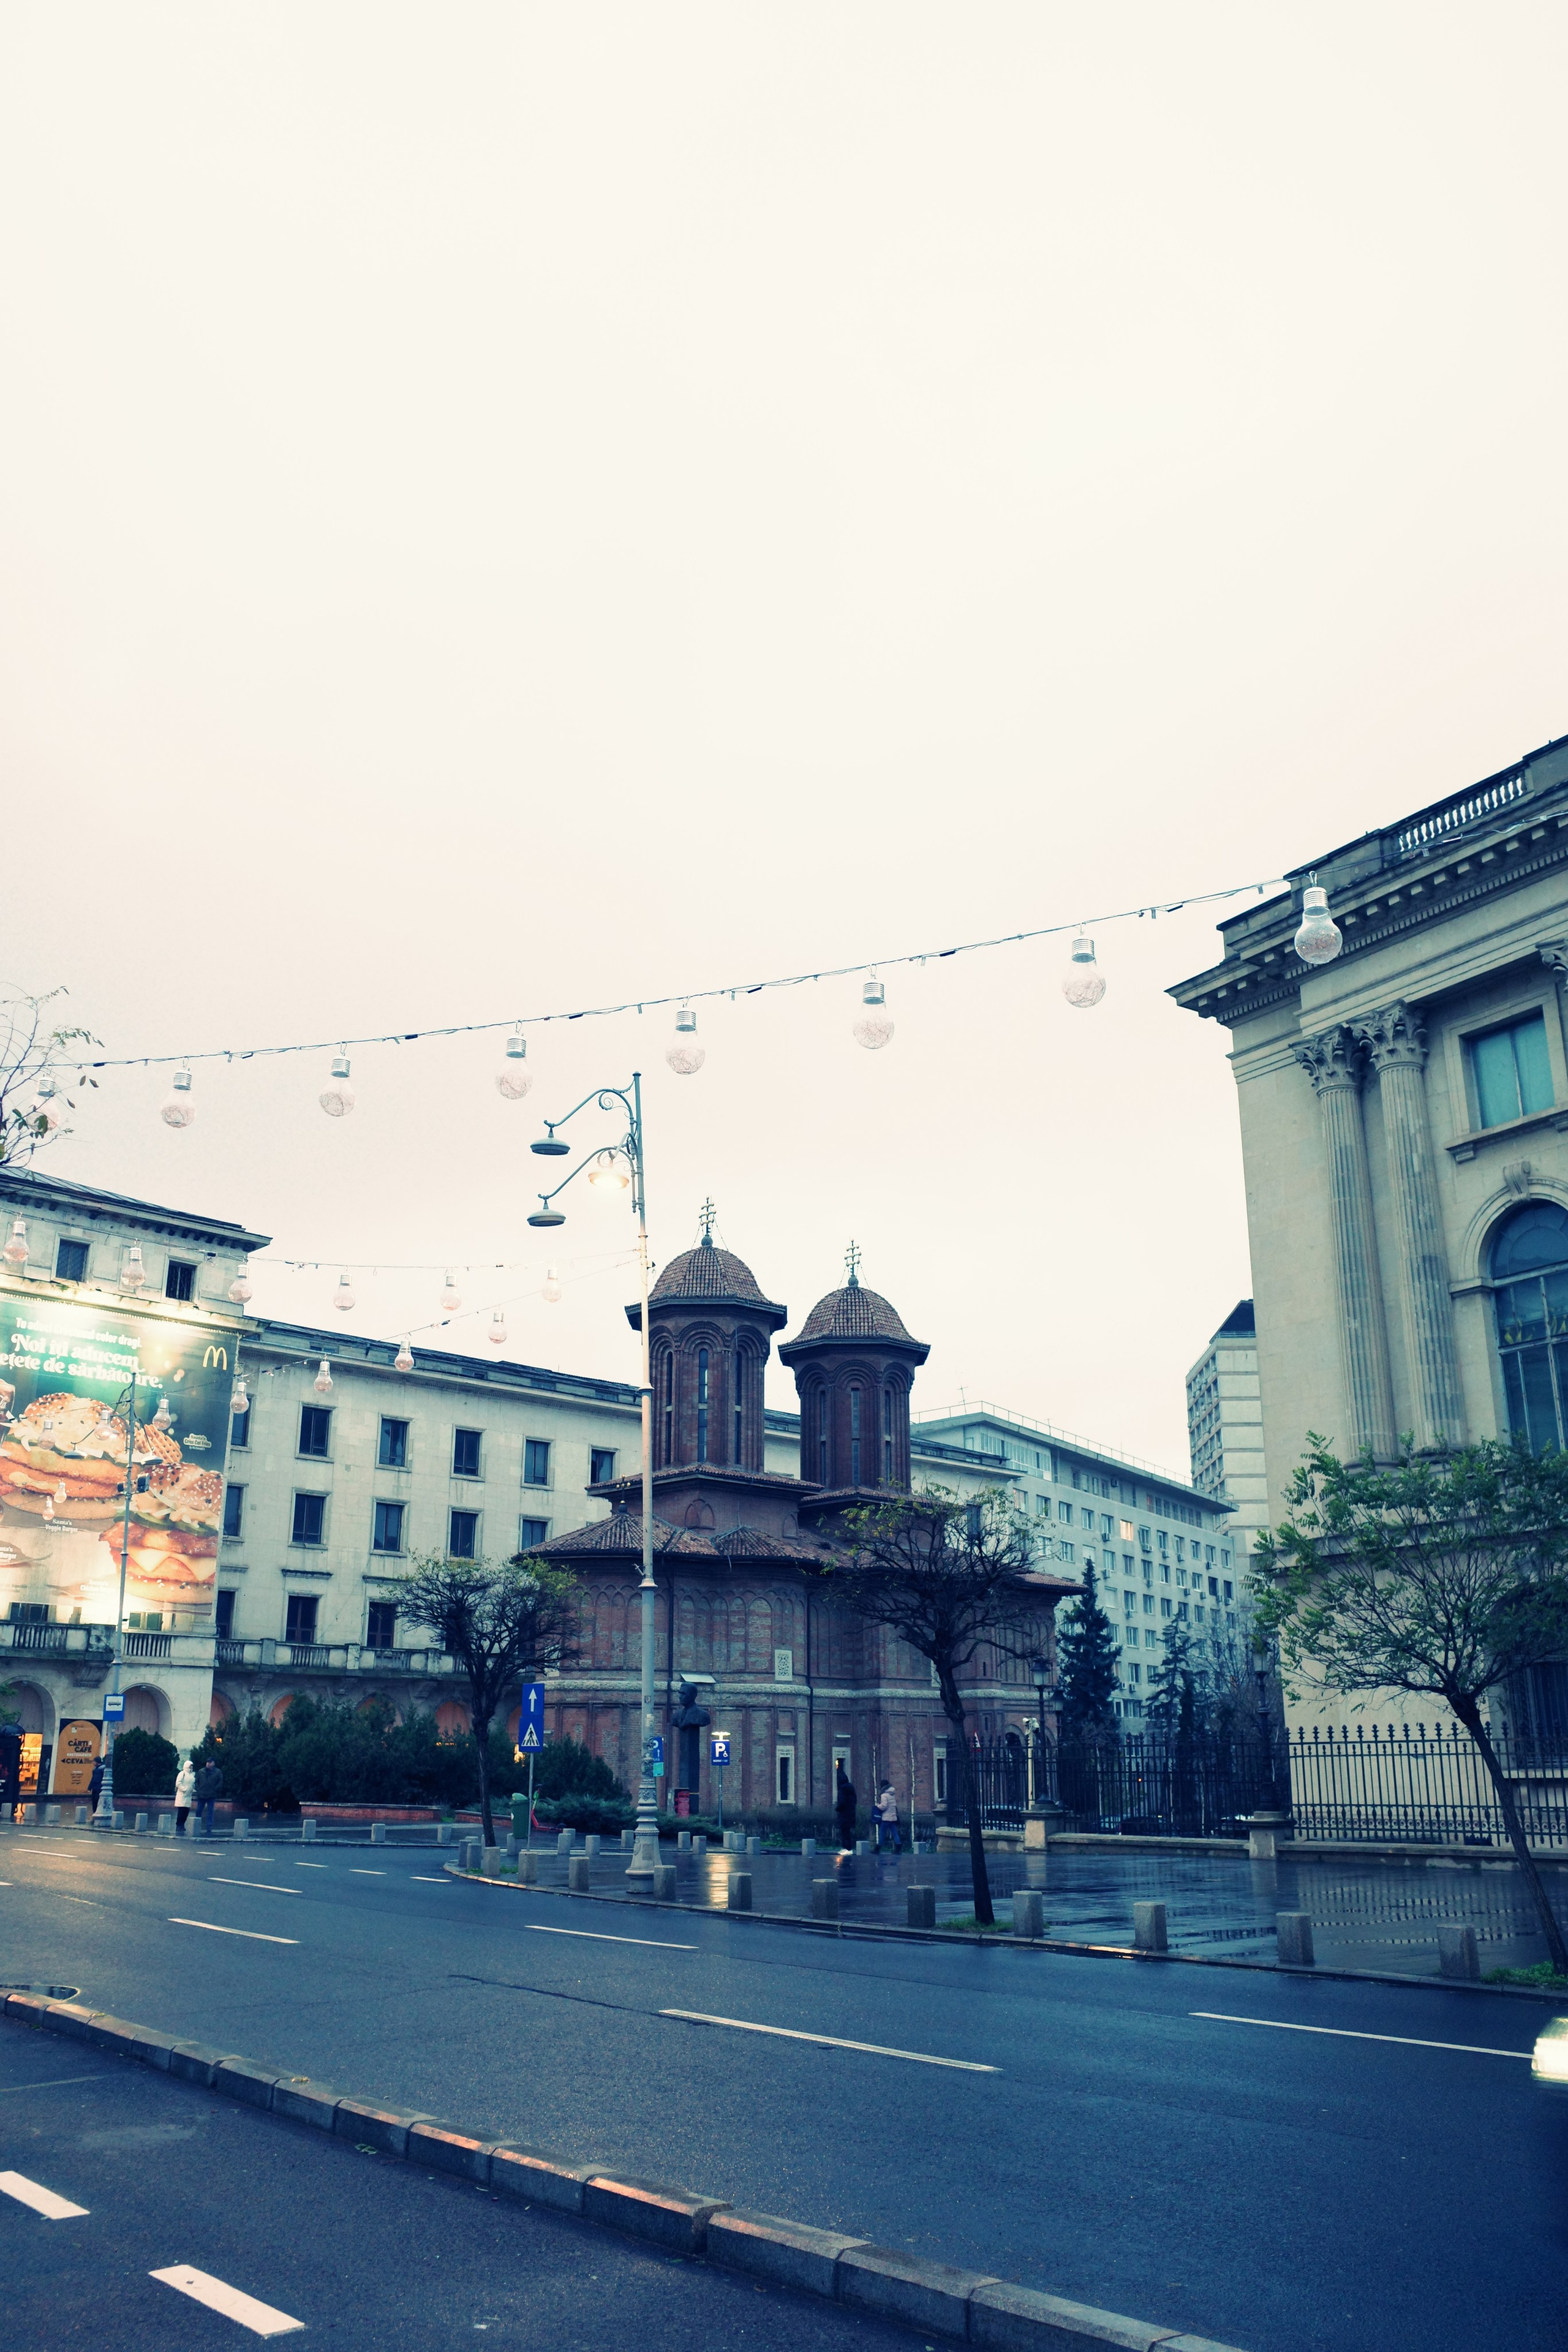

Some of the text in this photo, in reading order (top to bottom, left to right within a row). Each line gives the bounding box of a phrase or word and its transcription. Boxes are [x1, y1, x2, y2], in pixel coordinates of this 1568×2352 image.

[16, 1317, 26, 1329] Tu
[96, 1331, 118, 1344] celor
[118, 1334, 143, 1350] dragi.
[10, 1333, 46, 1354] Noi
[70, 1345, 146, 1373] aducem
[43, 1357, 66, 1374] de
[62, 1525, 78, 1534] Burger
[715, 1743, 726, 1757] P
